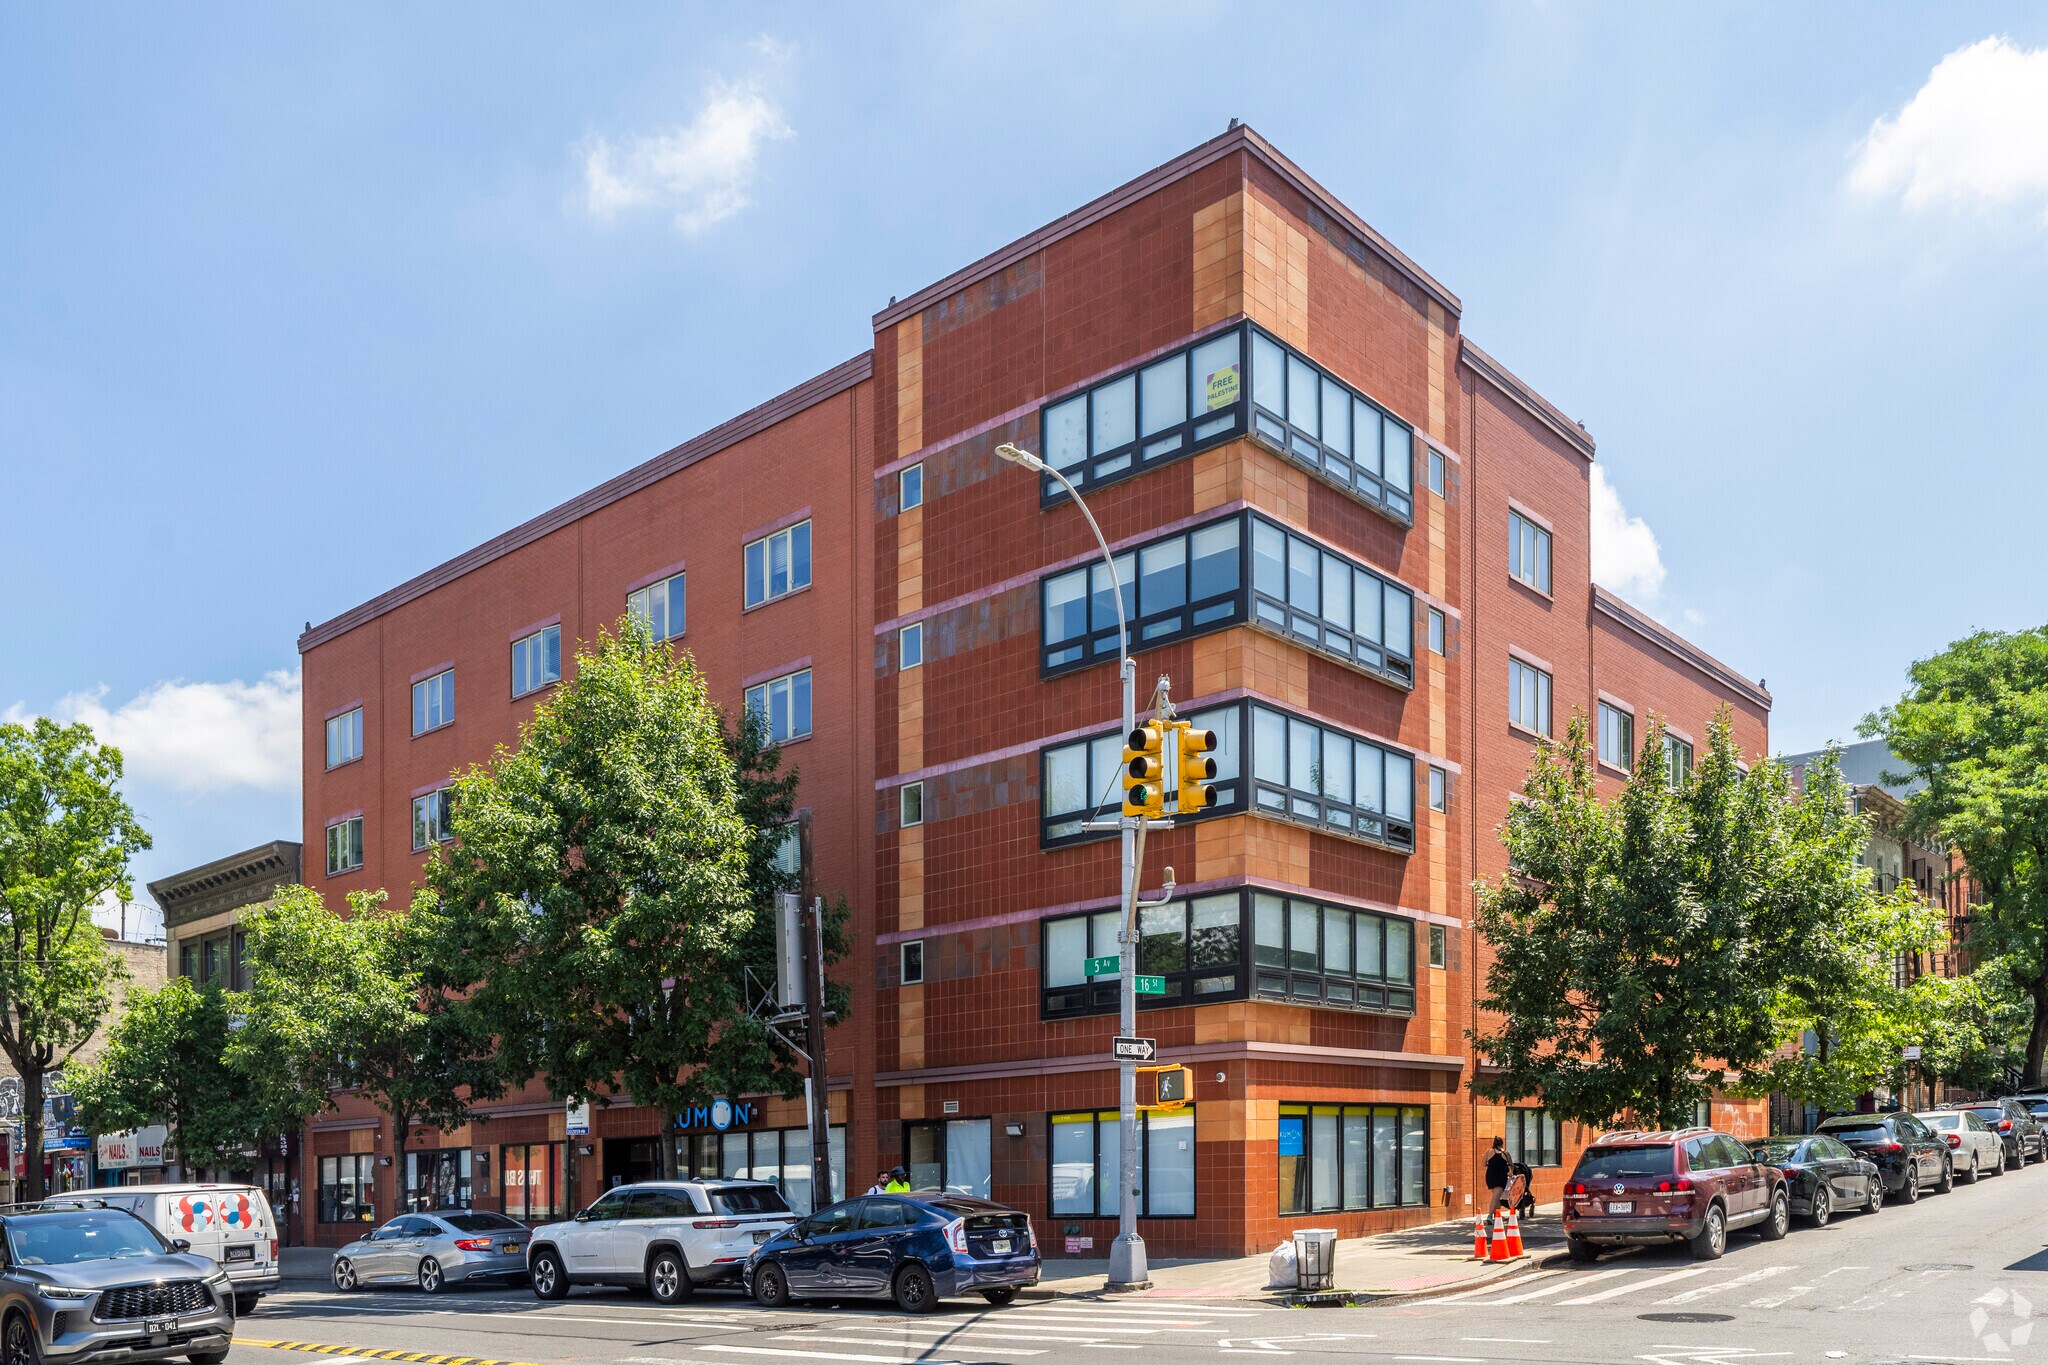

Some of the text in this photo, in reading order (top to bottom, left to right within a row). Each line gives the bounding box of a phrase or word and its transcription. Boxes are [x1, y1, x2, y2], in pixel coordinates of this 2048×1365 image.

[1212, 375, 1233, 390] FREE
[1207, 384, 1239, 401] PALESTINE
[1094, 959, 1111, 973] 5 Av
[1140, 978, 1158, 991] 16 St
[1120, 1044, 1150, 1055] ONE WAY
[674, 1098, 749, 1130] UMON
[109, 1143, 126, 1160] NAILS
[139, 1146, 161, 1157] NAILS
